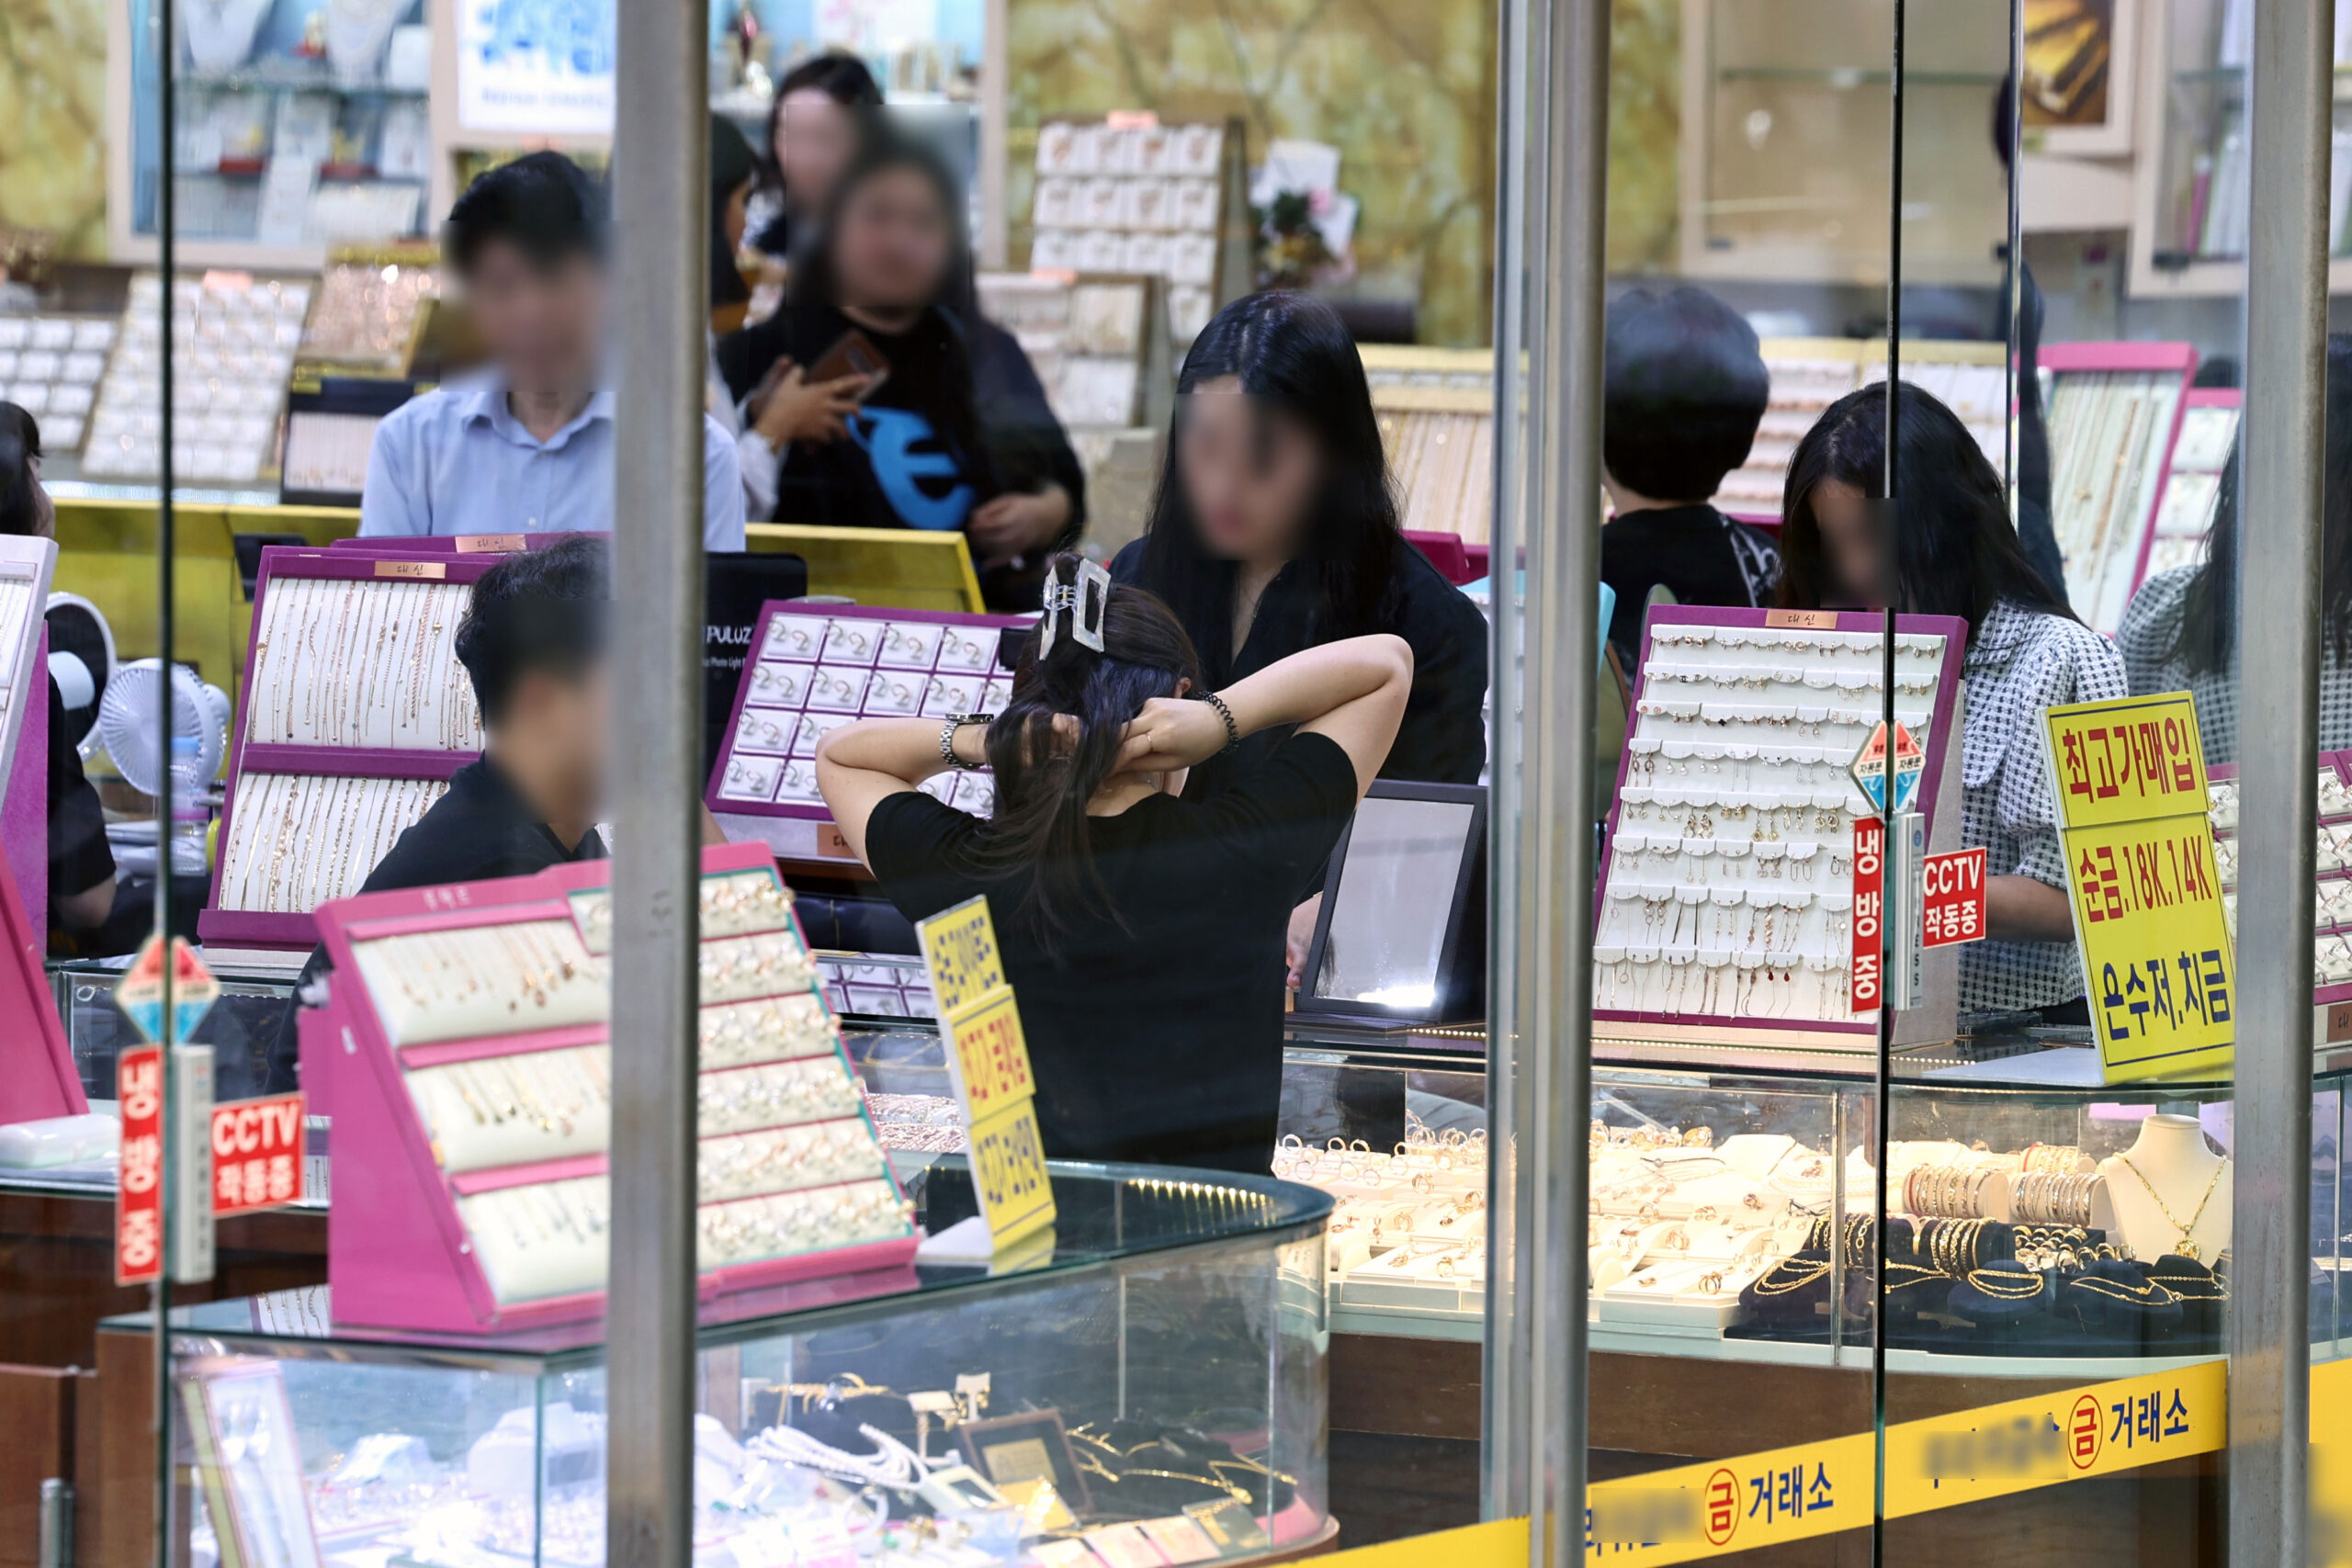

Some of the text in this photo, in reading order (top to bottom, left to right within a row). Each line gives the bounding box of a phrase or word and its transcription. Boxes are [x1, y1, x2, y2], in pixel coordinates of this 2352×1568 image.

[706, 625, 753, 644] PULUZ
[2062, 716, 2197, 804] 최고가매입
[1923, 853, 1982, 897] CCTV
[1853, 829, 1881, 1000] 냉방중
[1925, 899, 1978, 940] 작동중
[212, 1101, 300, 1156] CCTV
[2110, 1388, 2189, 1449] 거래소
[1747, 1461, 1834, 1525] 거래소
